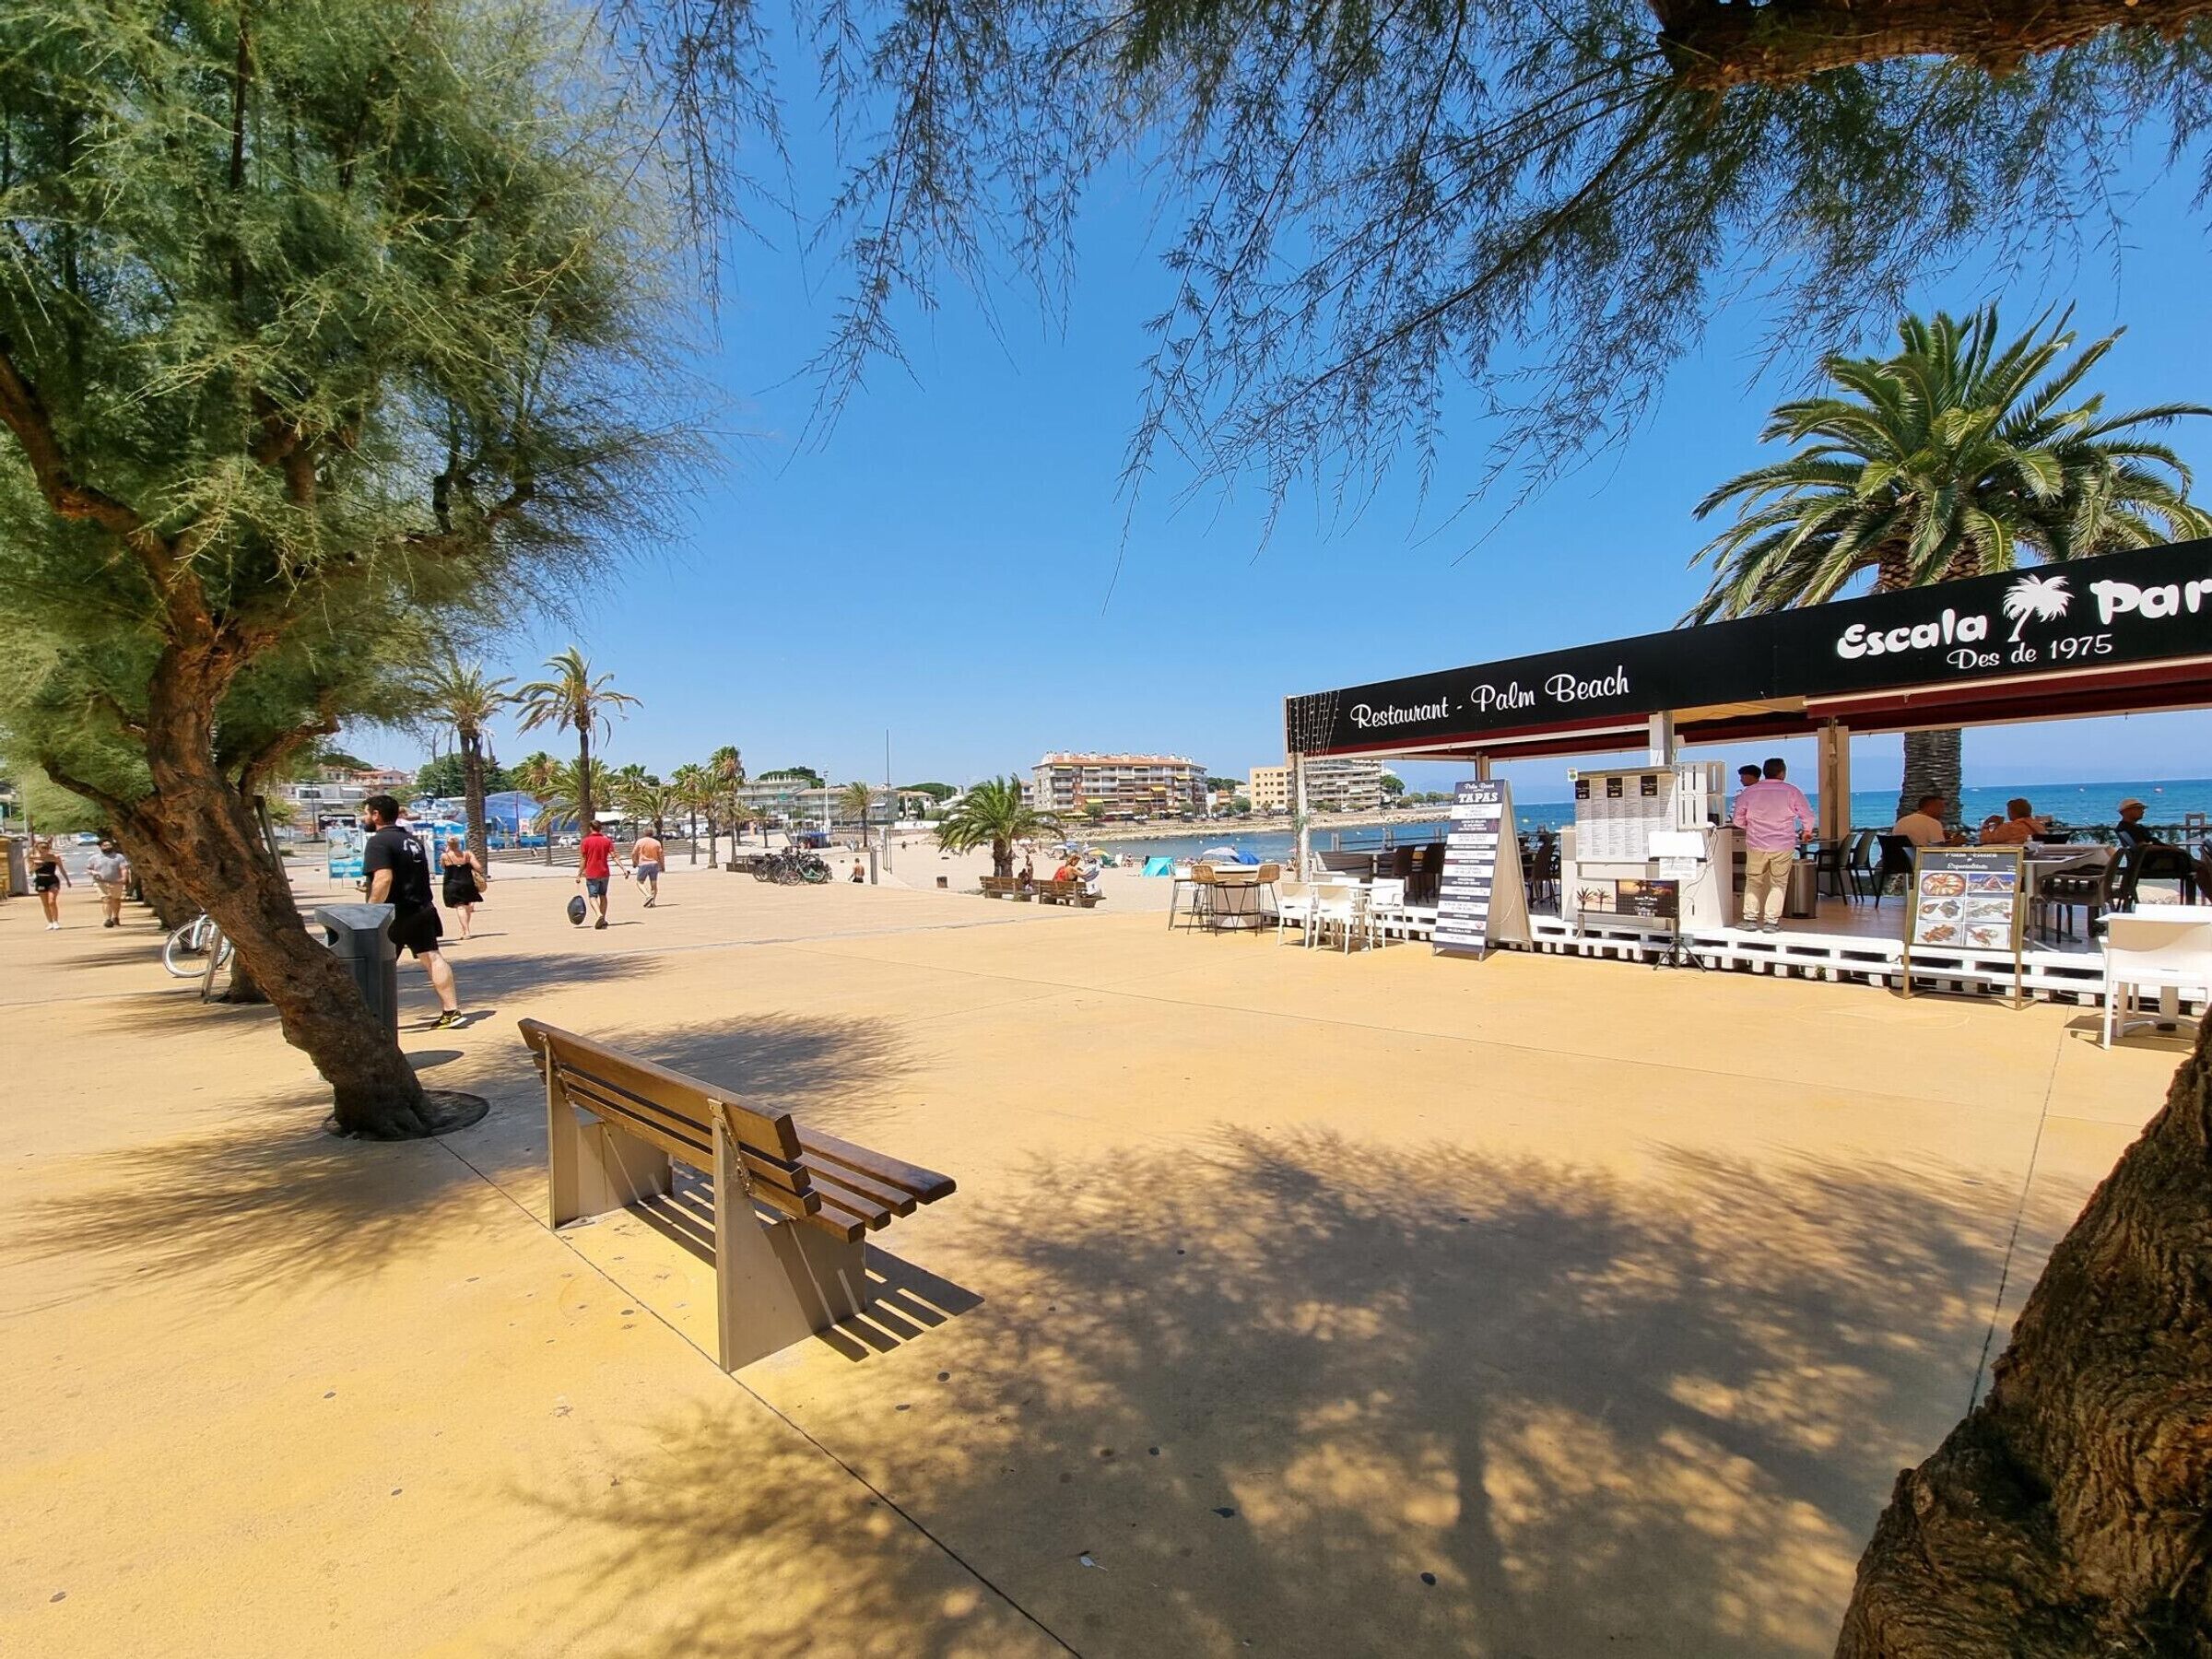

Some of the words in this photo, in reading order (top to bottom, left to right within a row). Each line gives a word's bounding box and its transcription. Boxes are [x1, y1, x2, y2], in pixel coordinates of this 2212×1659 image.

[1836, 607, 1988, 660] Escala
[1946, 648, 2000, 669] Des
[2008, 641, 2037, 664] de
[2050, 633, 2112, 660] 1975
[1349, 696, 1450, 729] Restaurant
[1470, 681, 1535, 712] Palm
[1544, 665, 1630, 703] Beach
[1458, 792, 1499, 804] TAPAS
